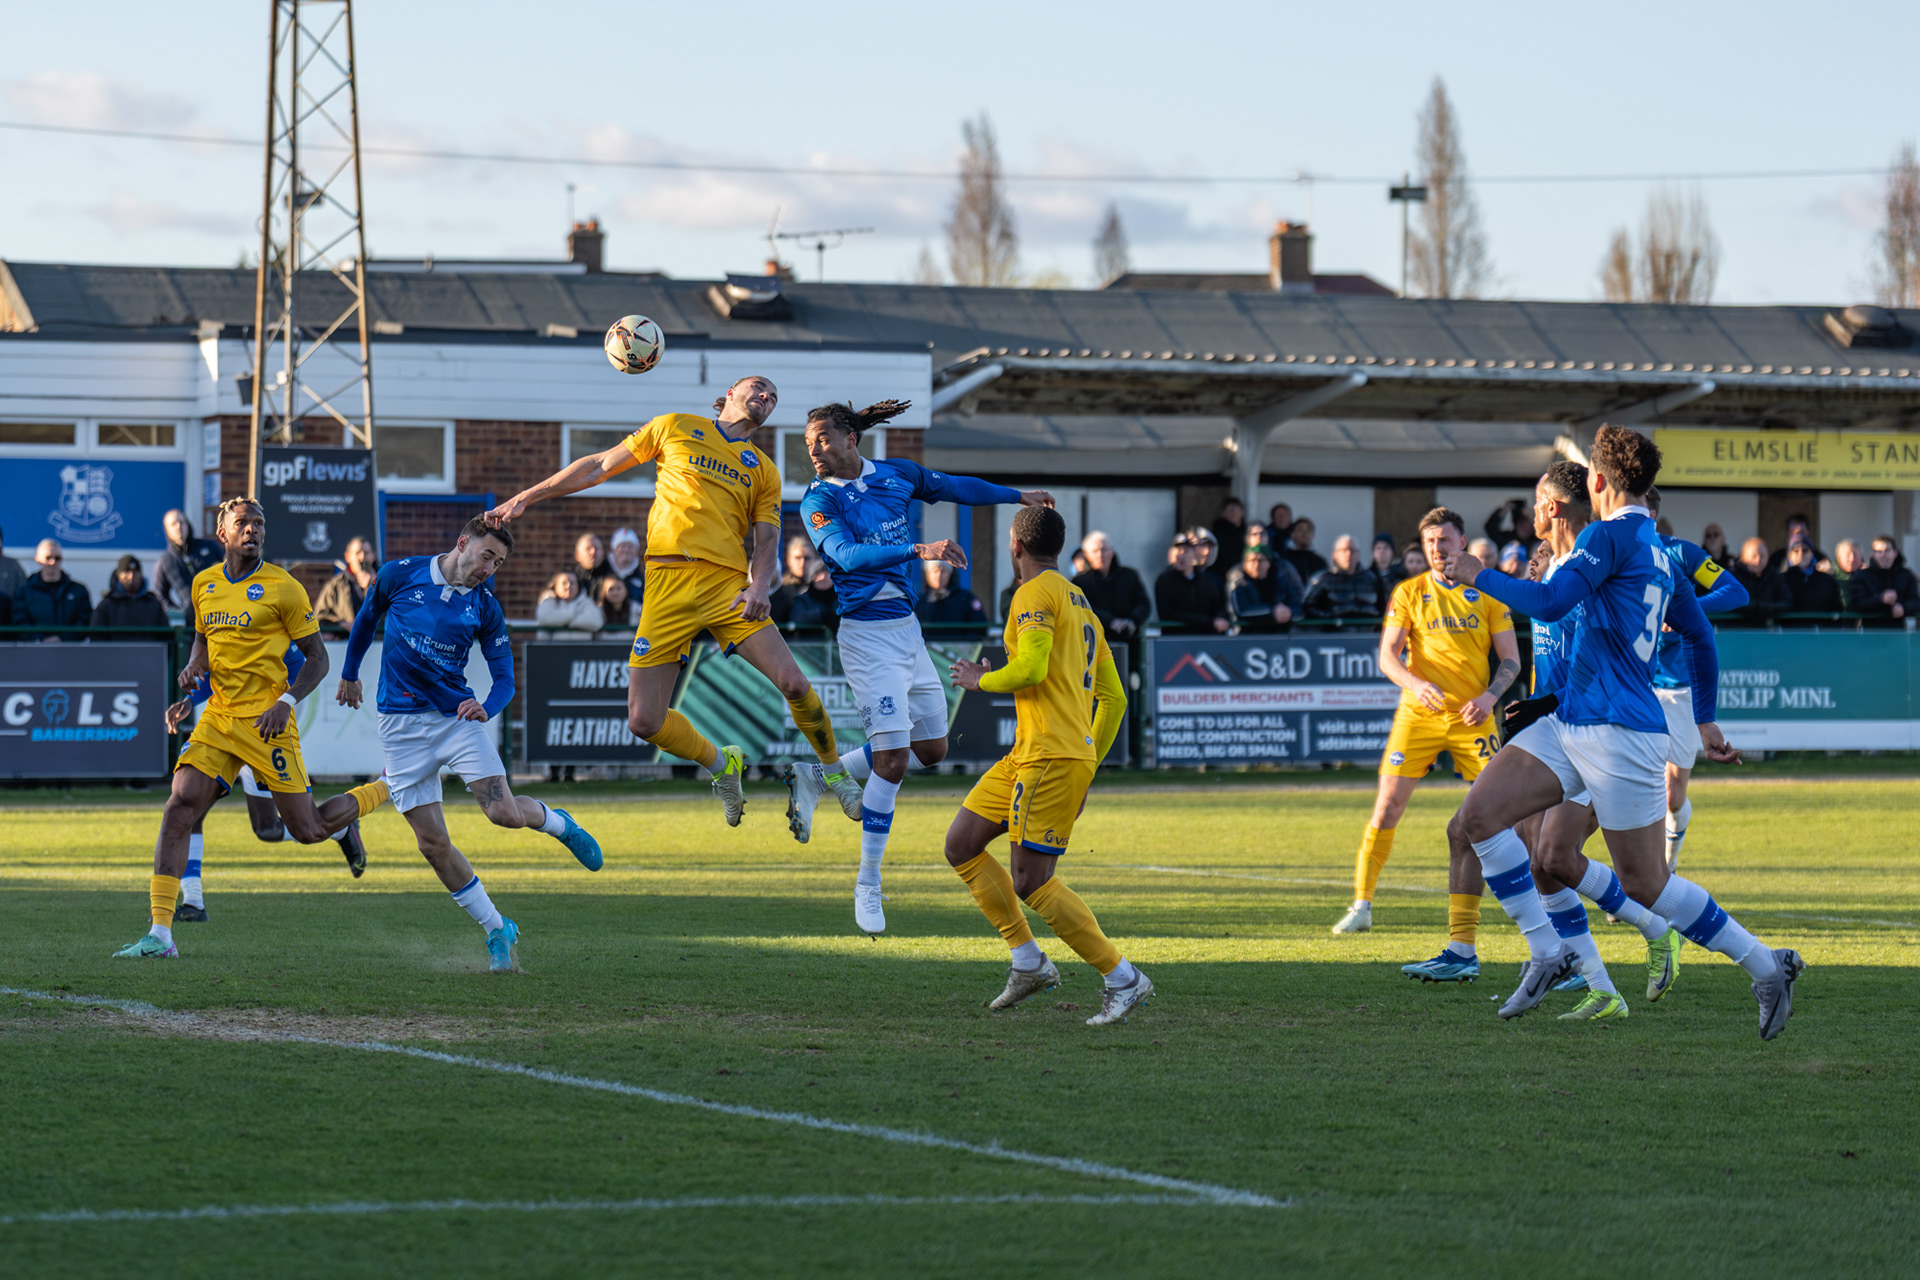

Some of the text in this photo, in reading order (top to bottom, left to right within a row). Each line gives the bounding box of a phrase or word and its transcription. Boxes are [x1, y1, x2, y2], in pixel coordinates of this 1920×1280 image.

[1713, 439, 1919, 464] ELMSLIE STAN
[688, 454, 740, 480] utilita
[714, 473, 737, 488] power
[1705, 562, 1720, 574] C
[203, 612, 238, 626] utilita
[1427, 615, 1467, 631] utilita
[1632, 583, 1670, 664] 3
[423, 636, 457, 652] Brunel
[1083, 622, 1097, 691] 2
[1245, 647, 1312, 680] S&D
[569, 660, 631, 689] HAYES
[1719, 669, 1780, 687] ATFORD
[1162, 692, 1226, 705] BUILDERS
[1229, 690, 1315, 704] MERCHANTS
[1160, 715, 1287, 730] COME TO US FOR ALL
[1318, 719, 1346, 734] visit
[1349, 721, 1365, 733] us
[31, 727, 139, 742] BARBERSHOP
[546, 717, 652, 746] HEATHRO
[1160, 729, 1297, 744] YOUR CONSTRUCTION
[1204, 746, 1227, 758] BIG
[1228, 746, 1247, 757] OR
[1247, 744, 1289, 757] SMALL
[1474, 733, 1500, 758] 20
[271, 746, 287, 772] 6
[1012, 781, 1024, 812] 2
